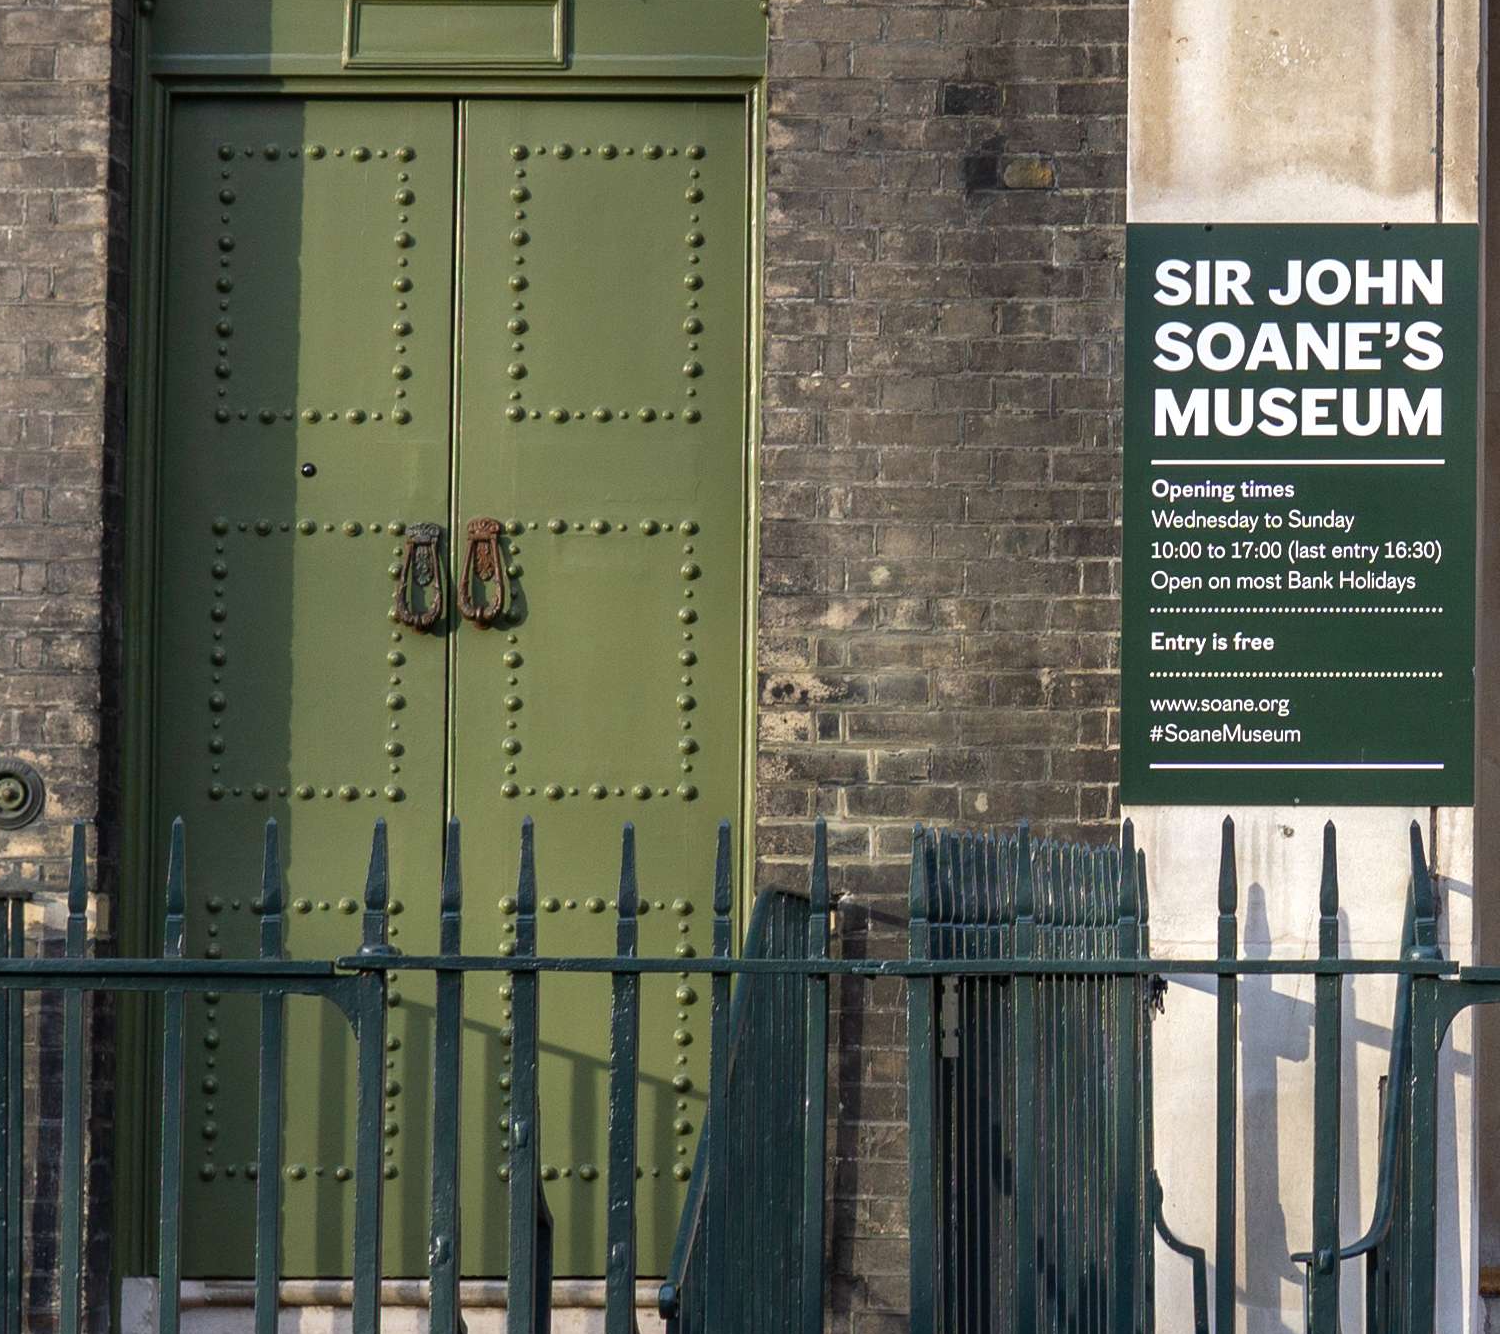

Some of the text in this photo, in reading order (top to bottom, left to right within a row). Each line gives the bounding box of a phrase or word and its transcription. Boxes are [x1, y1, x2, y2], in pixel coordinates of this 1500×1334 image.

[1153, 258, 1444, 307] SIR JOHN
[1154, 387, 1443, 437] MUSEUM
[1151, 478, 1295, 503] Opening times
[1151, 508, 1355, 534] Wednesday to Sunday
[1151, 539, 1442, 565] 10:00 to 17:00 (last entry 16:30)
[1150, 570, 1416, 595] Open on most Bank Holidays
[1151, 631, 1275, 656] Entry is free
[1149, 698, 1290, 717] www.soane.org
[1149, 723, 1301, 743] #SoaneMuseum
